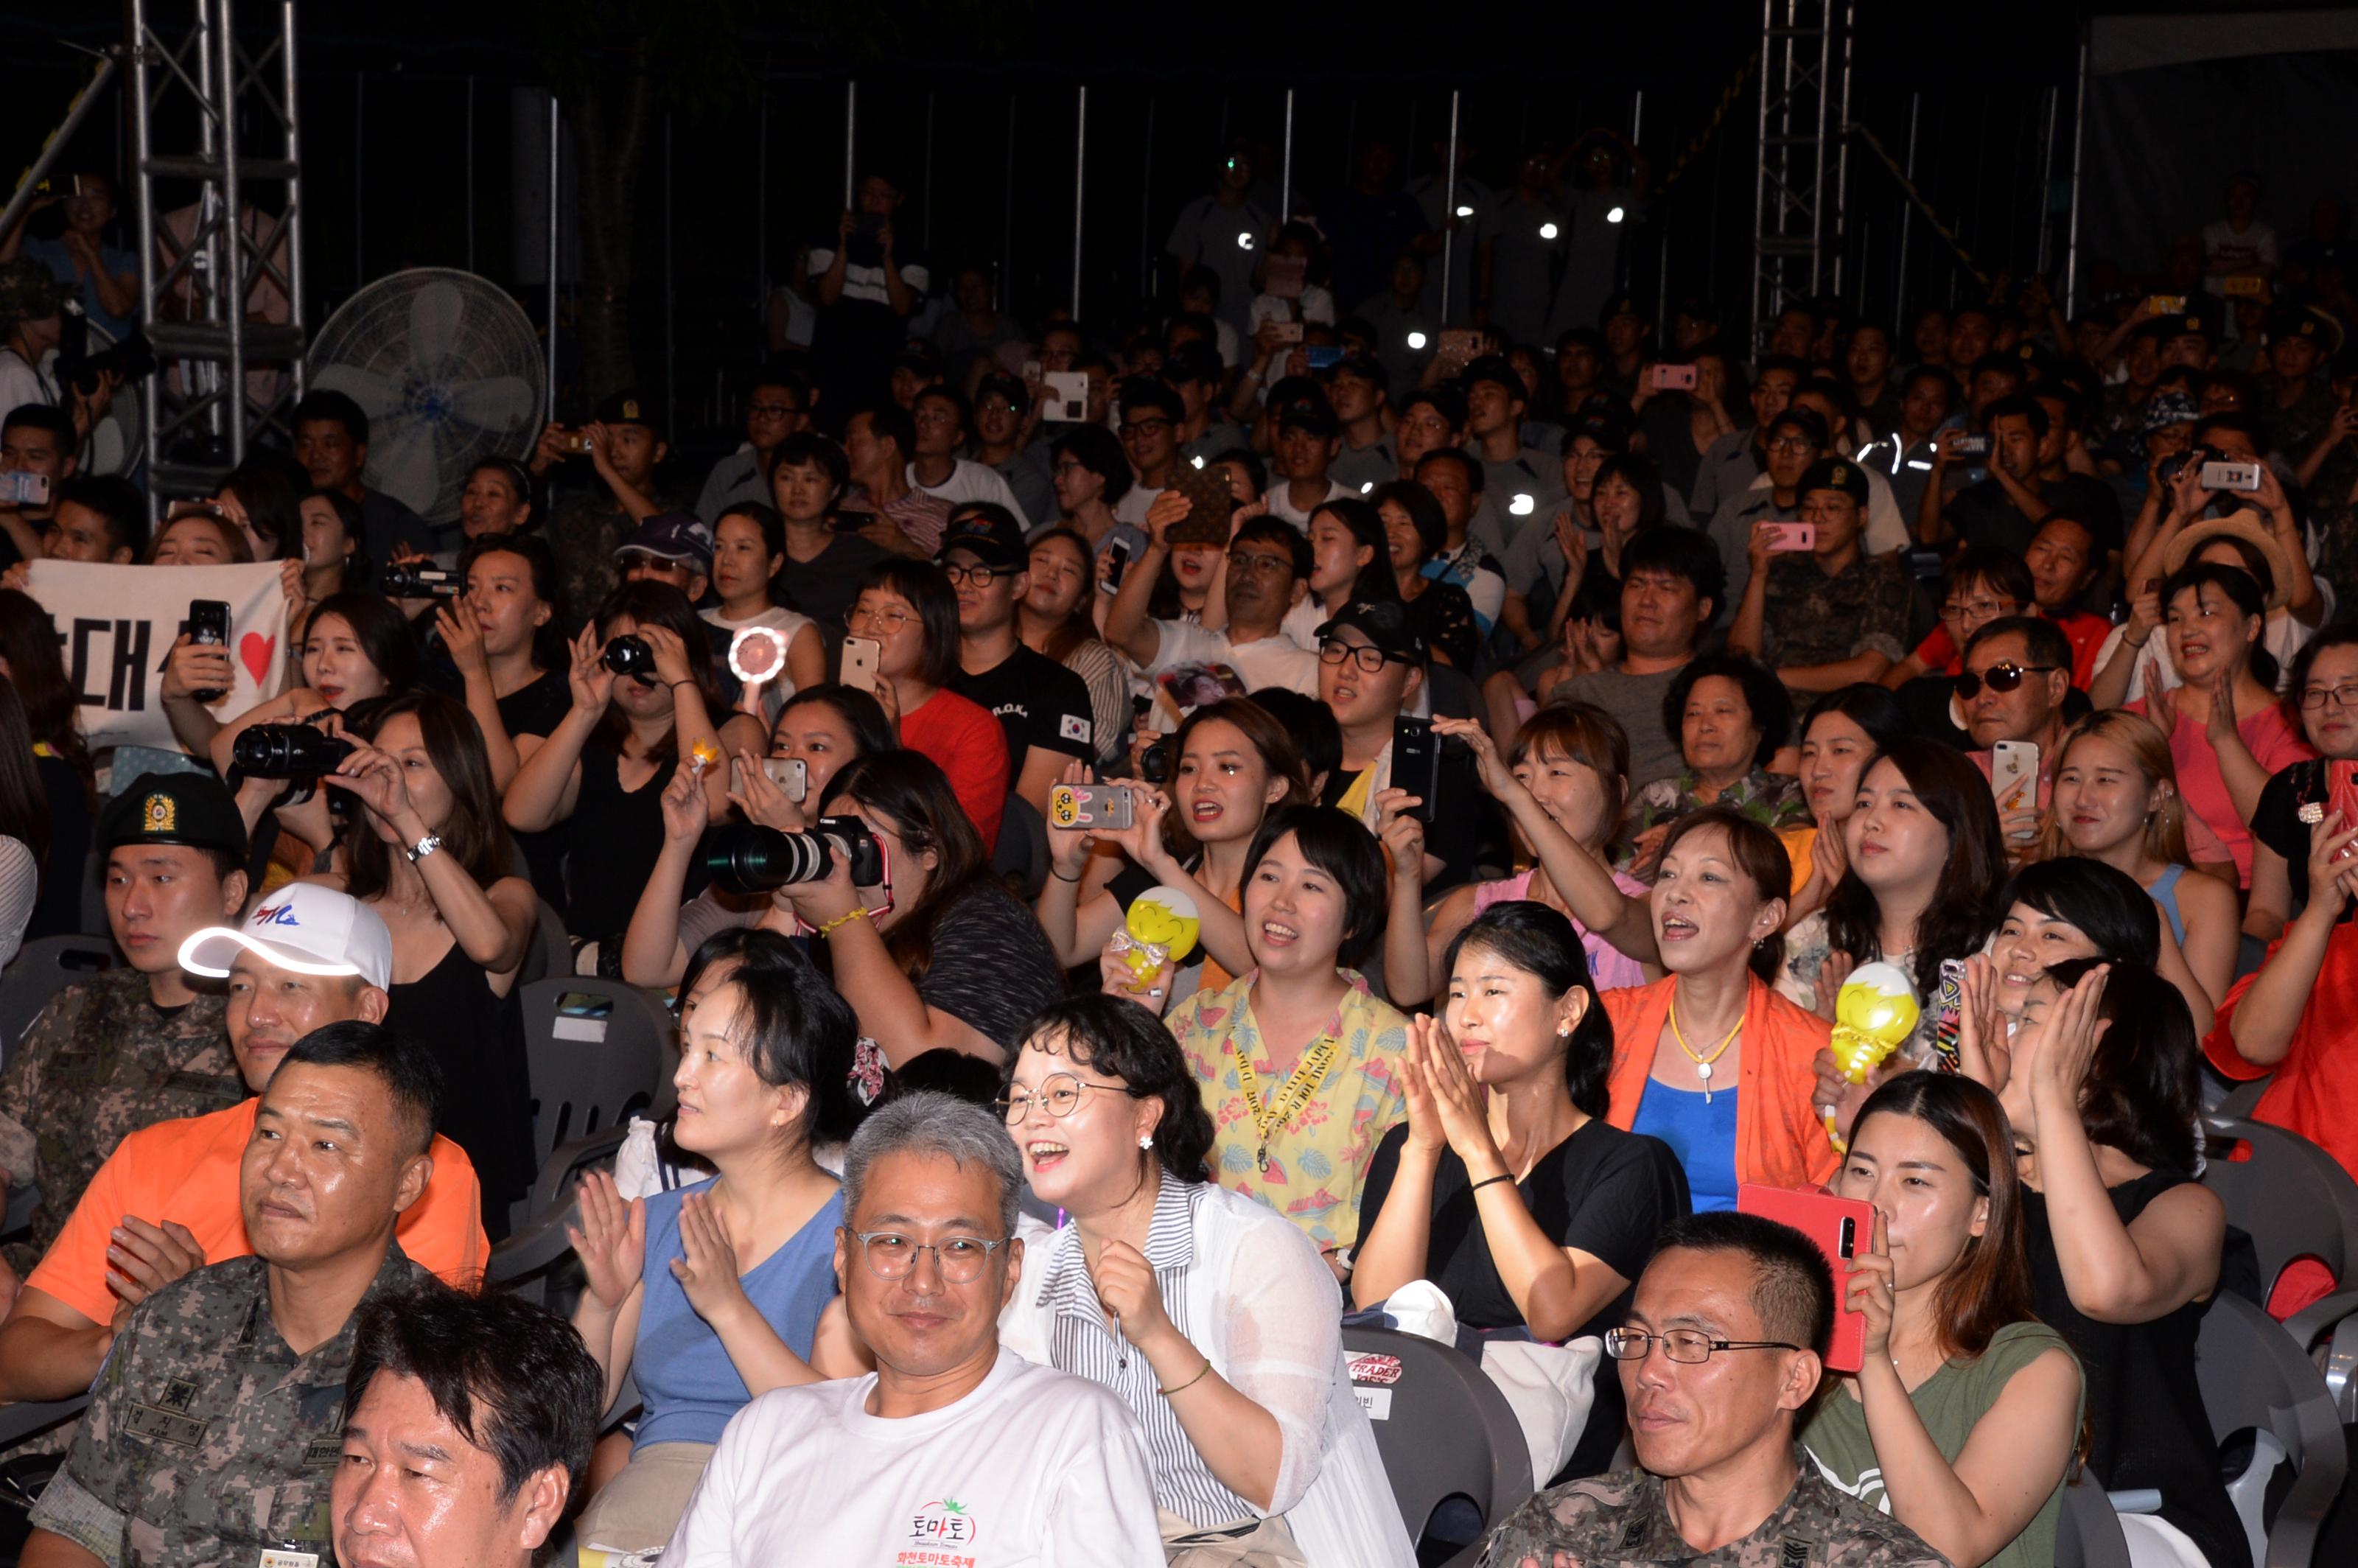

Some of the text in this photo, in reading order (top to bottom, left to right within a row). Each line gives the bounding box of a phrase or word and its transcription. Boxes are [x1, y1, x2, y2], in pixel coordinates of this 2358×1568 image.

[1351, 1364, 1400, 1378] TRADER
[307, 1446, 342, 1457] 대한민
[909, 1516, 965, 1540] 토마토
[897, 1552, 976, 1568] 화천토마토축제
